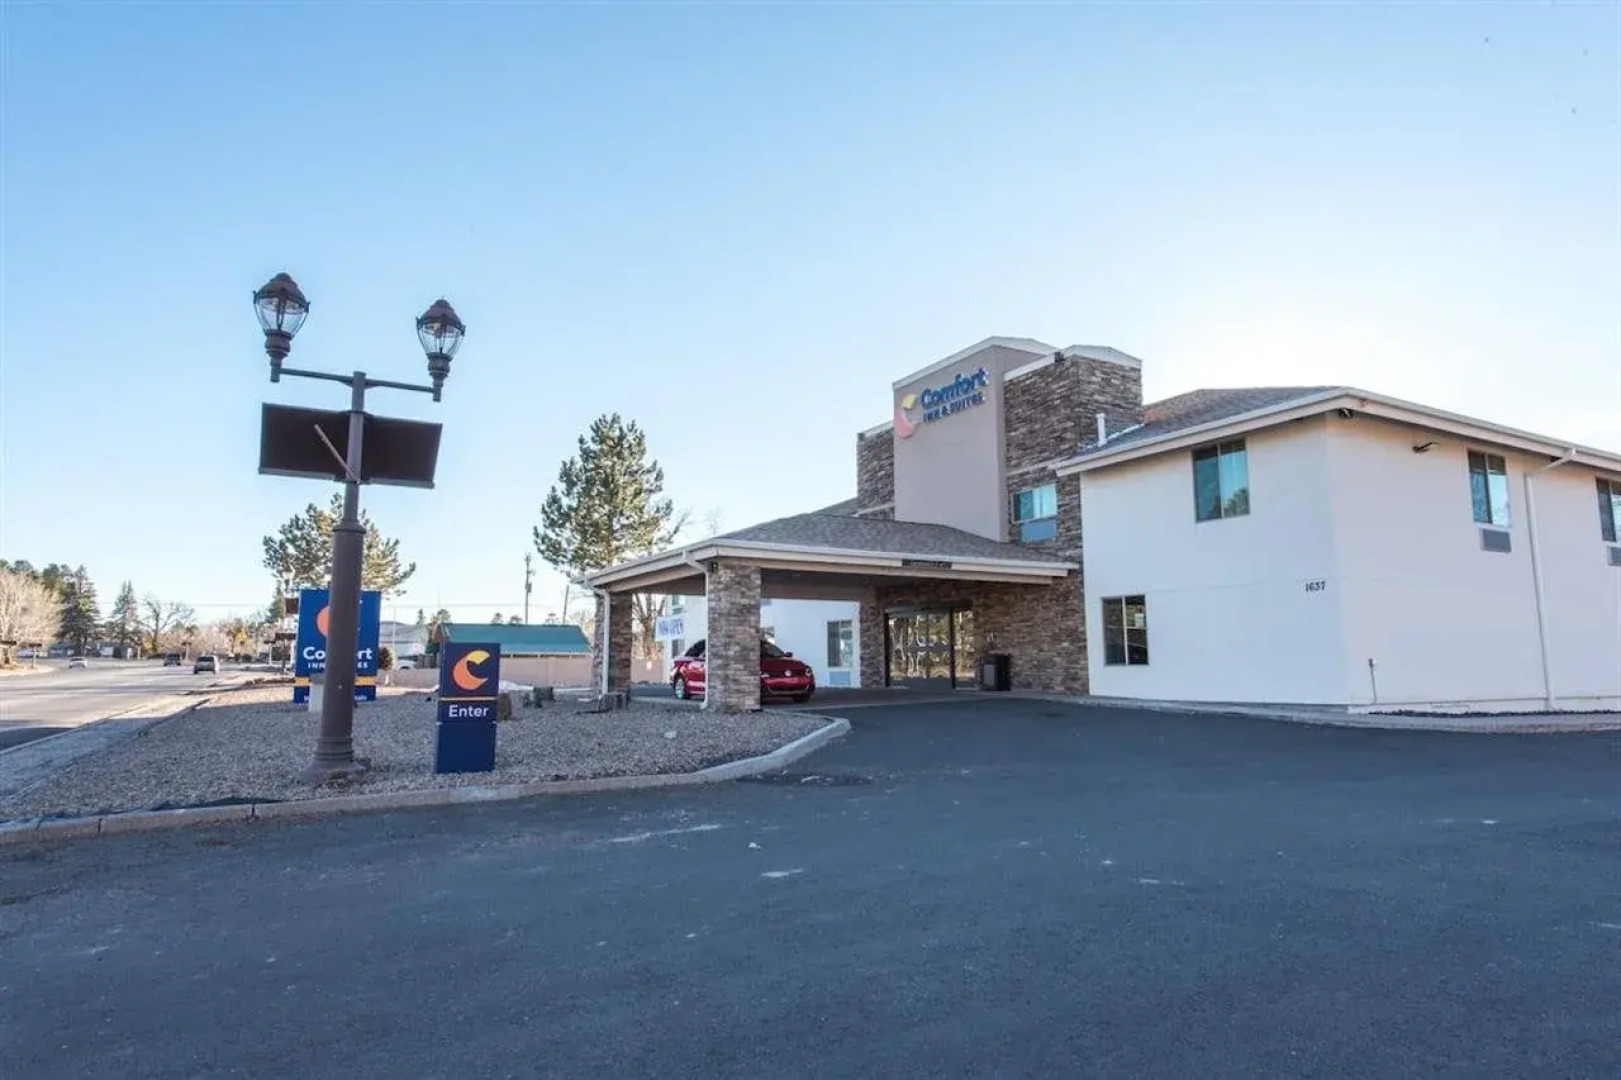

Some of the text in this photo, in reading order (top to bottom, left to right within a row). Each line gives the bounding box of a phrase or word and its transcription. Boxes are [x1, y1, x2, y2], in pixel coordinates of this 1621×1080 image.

[921, 368, 989, 409] Comfort
[922, 409, 941, 423] INN
[950, 392, 985, 414] SUITES
[303, 646, 372, 660] Cort
[449, 704, 489, 718] Enter
